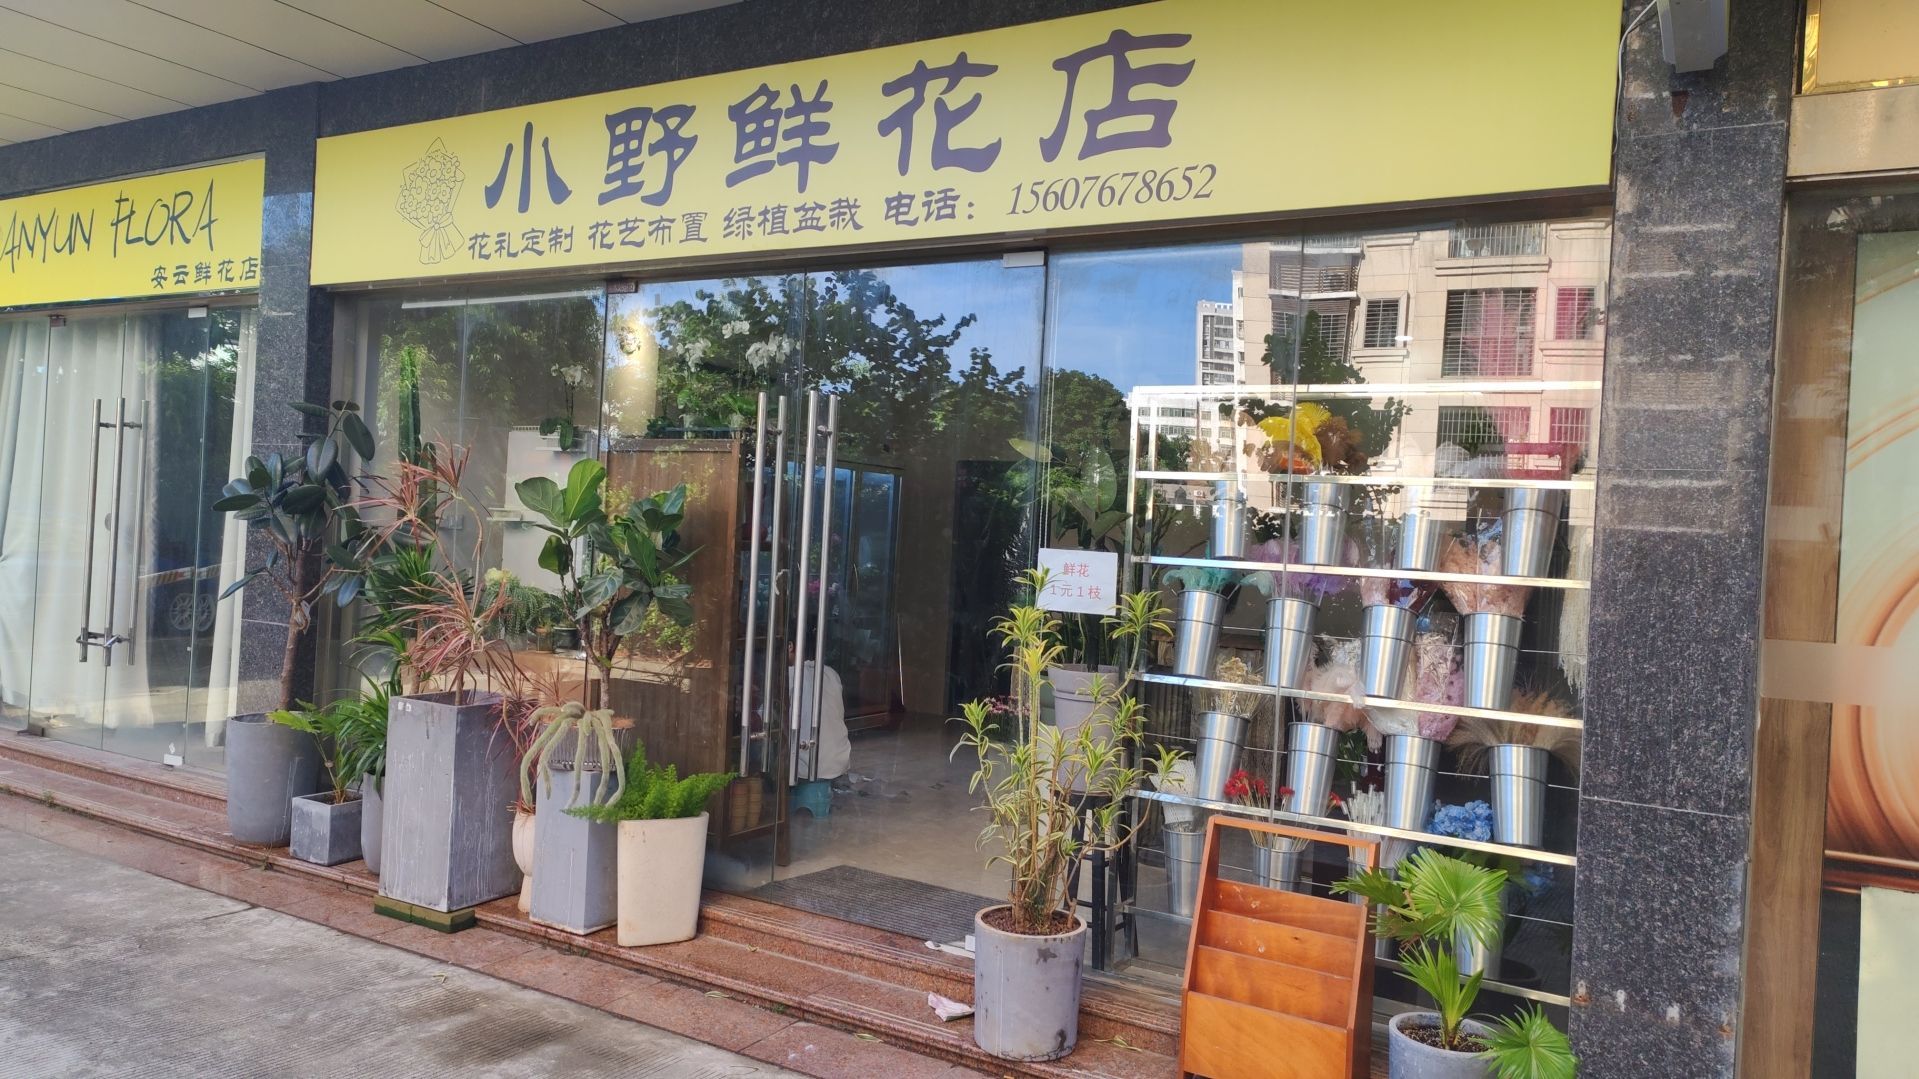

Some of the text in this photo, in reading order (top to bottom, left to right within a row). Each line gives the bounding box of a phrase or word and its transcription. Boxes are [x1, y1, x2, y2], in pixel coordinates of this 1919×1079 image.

[485, 29, 1195, 213] 小野鲜花店
[110, 177, 218, 258] FLORA
[467, 225, 574, 261] 花礼定制
[588, 212, 708, 250] 花艺布置
[723, 197, 863, 241] 绿植盆栽
[1006, 163, 1217, 216] 15607678652
[150, 256, 259, 289] 安云鲜花店
[1063, 562, 1090, 578] 鲜花
